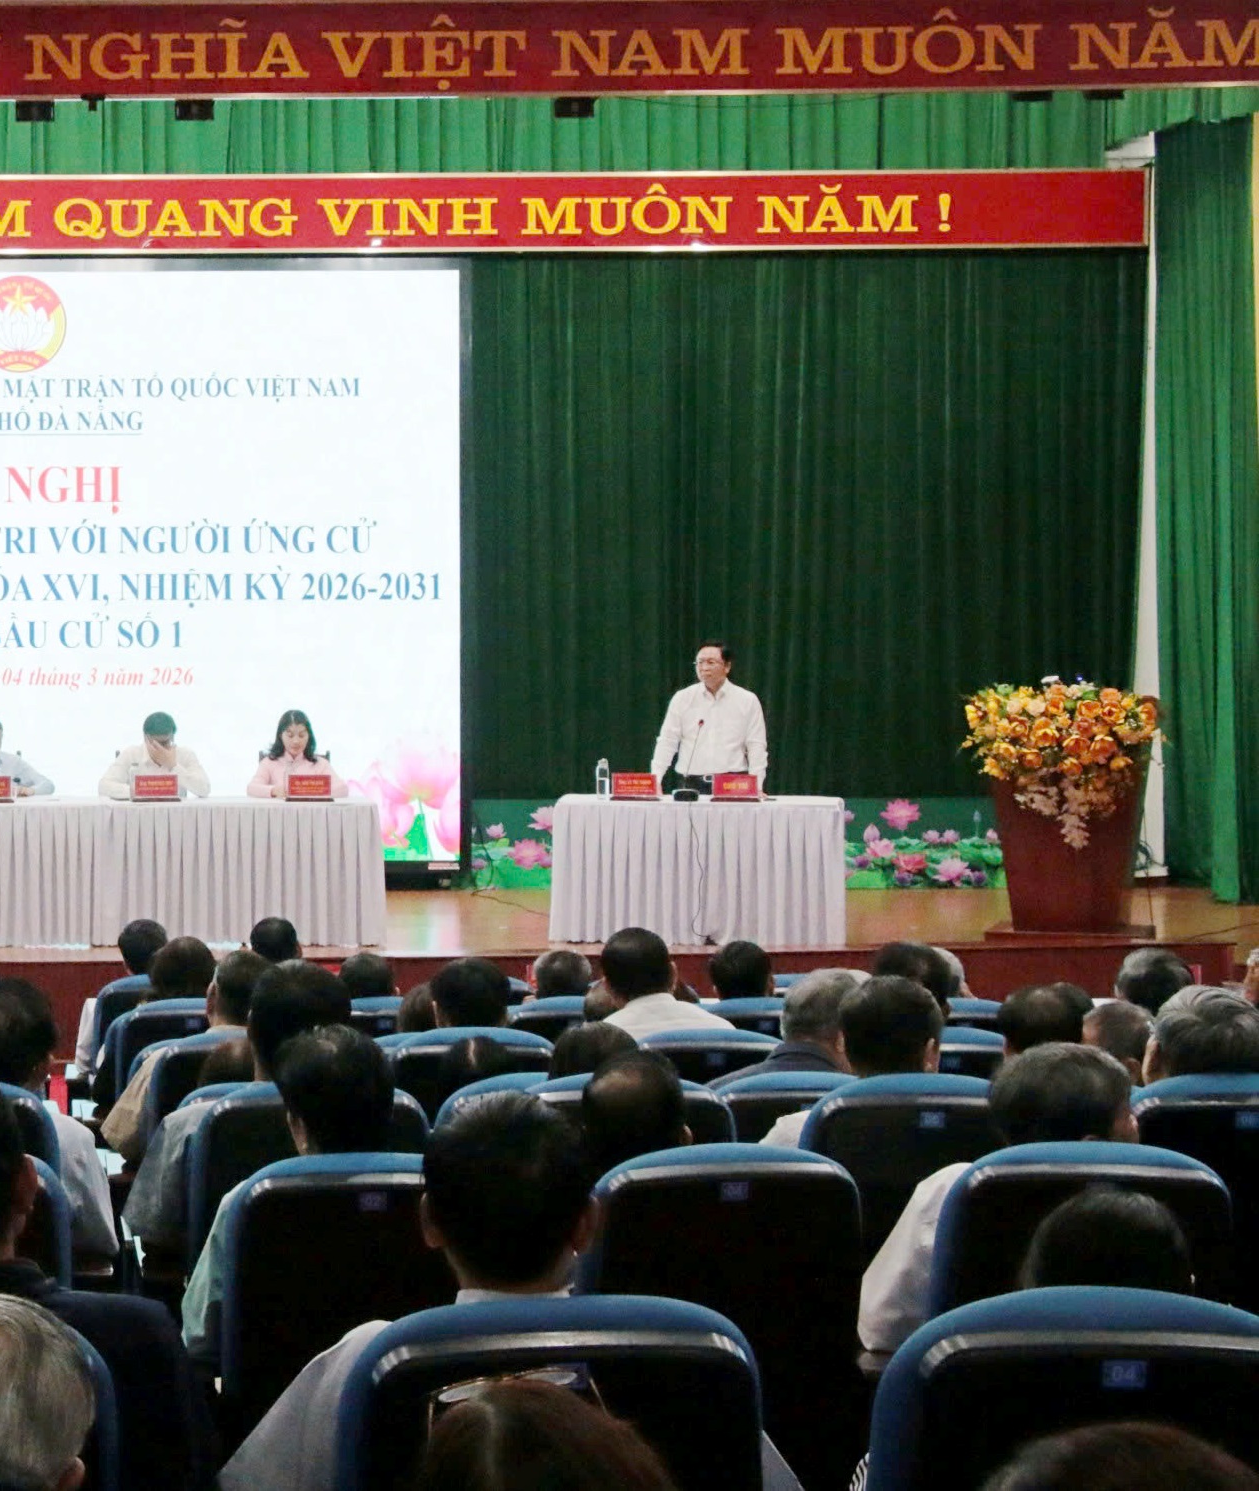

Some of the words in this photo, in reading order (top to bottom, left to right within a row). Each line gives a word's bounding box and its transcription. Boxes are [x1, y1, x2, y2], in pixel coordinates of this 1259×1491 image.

[27, 18, 309, 80] NGHĨA
[322, 15, 525, 90] VIỆT
[553, 29, 749, 76] NAM
[777, 9, 1039, 74] MUÔN
[1069, 6, 1259, 70] NĂM
[53, 198, 298, 240] QUANG
[316, 198, 498, 239] VINH
[521, 183, 733, 235] MUÔN
[757, 184, 918, 233] NĂM
[4, 376, 55, 404] MẶT
[61, 375, 124, 403] TRẬN
[131, 375, 163, 398] TỔ
[171, 372, 238, 401] QUỐC
[246, 378, 300, 403] VIỆT
[307, 377, 359, 397] NAM
[38, 406, 69, 431] ĐÀ
[77, 405, 143, 430] NẴNG
[7, 466, 120, 514] NGHỊ
[48, 519, 107, 554] VỚI
[119, 518, 230, 554] NGƯỜI
[243, 518, 315, 554] ỨNG
[326, 517, 377, 554] CỬ
[42, 574, 109, 606] XVI,
[119, 568, 232, 608] NHIỆM
[245, 565, 291, 601] KỲ
[301, 572, 440, 601] 2026-2031
[59, 613, 110, 648] CỬ
[117, 612, 160, 648] SỐ
[173, 620, 181, 648] 1
[2, 669, 22, 685] 04
[29, 668, 80, 690] tháng
[87, 668, 98, 686] 3
[104, 670, 143, 687] năm
[150, 668, 193, 685] 2026
